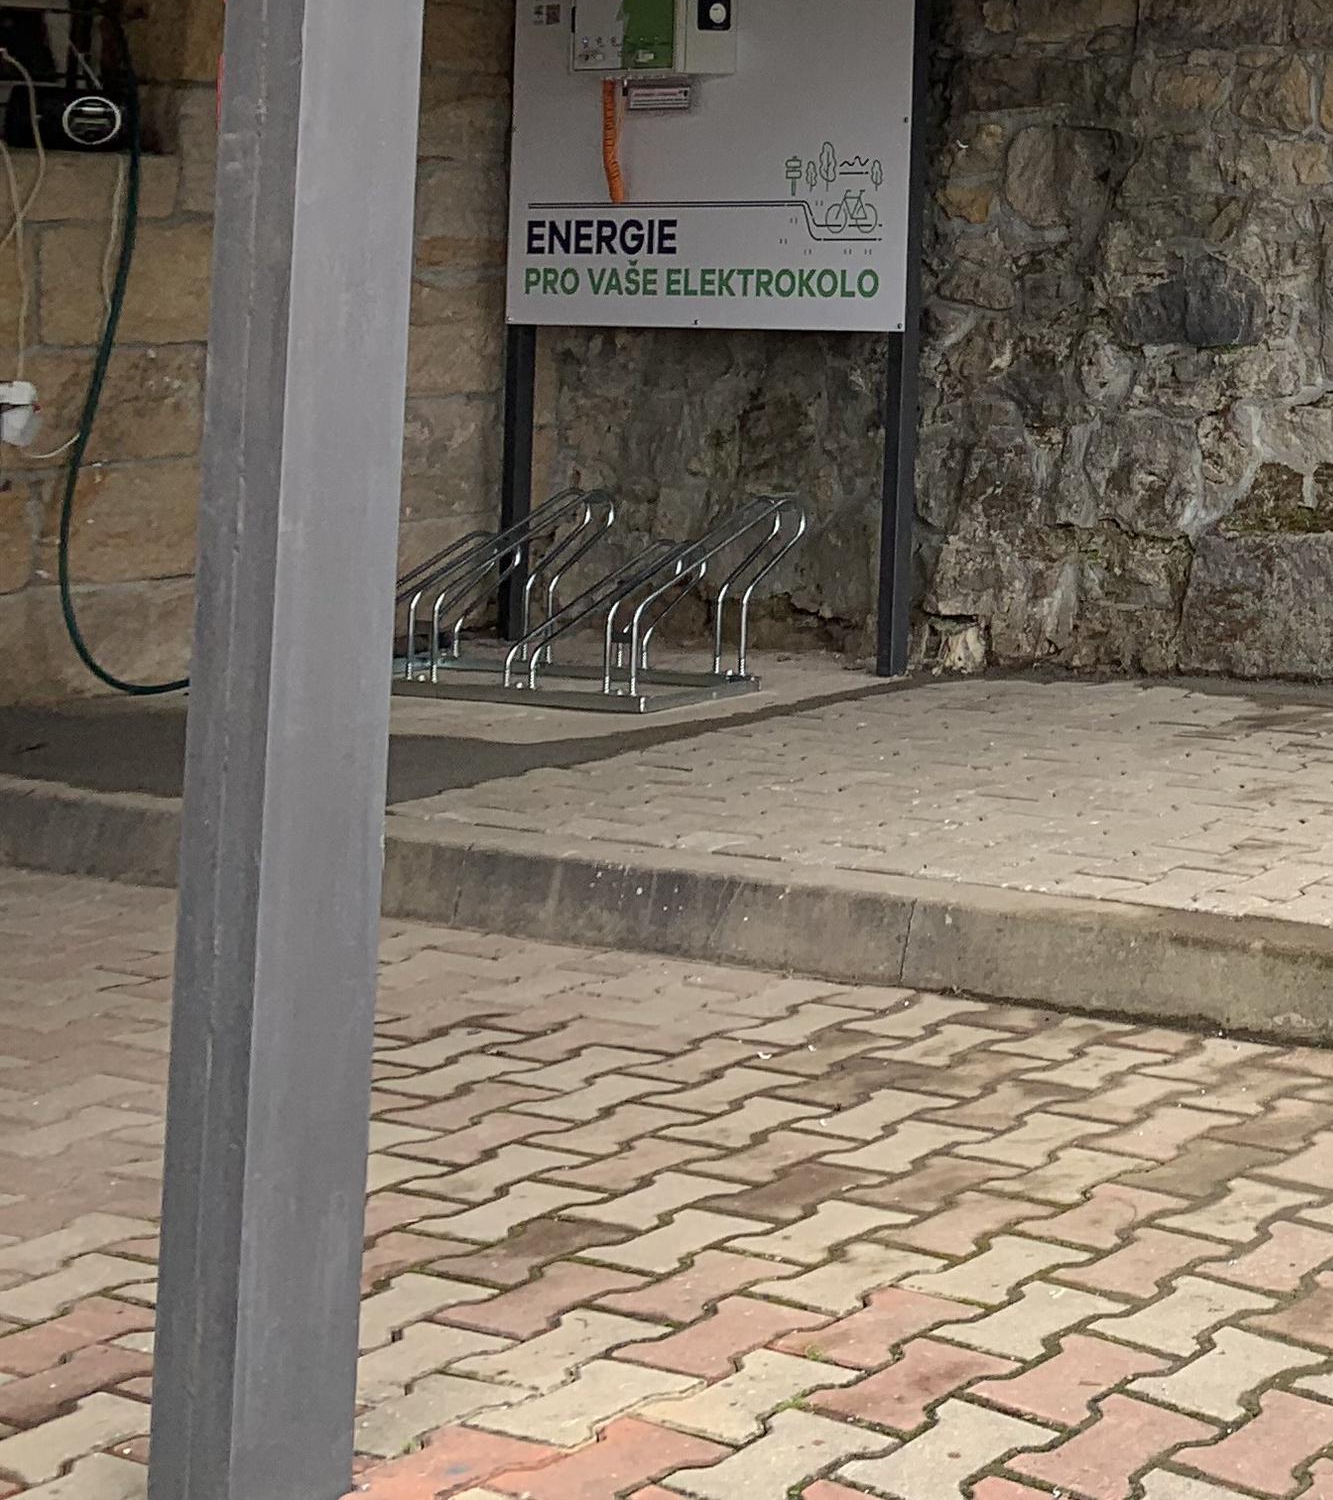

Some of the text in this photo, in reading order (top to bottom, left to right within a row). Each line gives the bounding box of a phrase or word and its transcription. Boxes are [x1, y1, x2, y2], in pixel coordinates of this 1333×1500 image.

[526, 219, 678, 255] ENERGIE
[524, 259, 880, 298] PRO VAŠE ELEKTROKOLO
